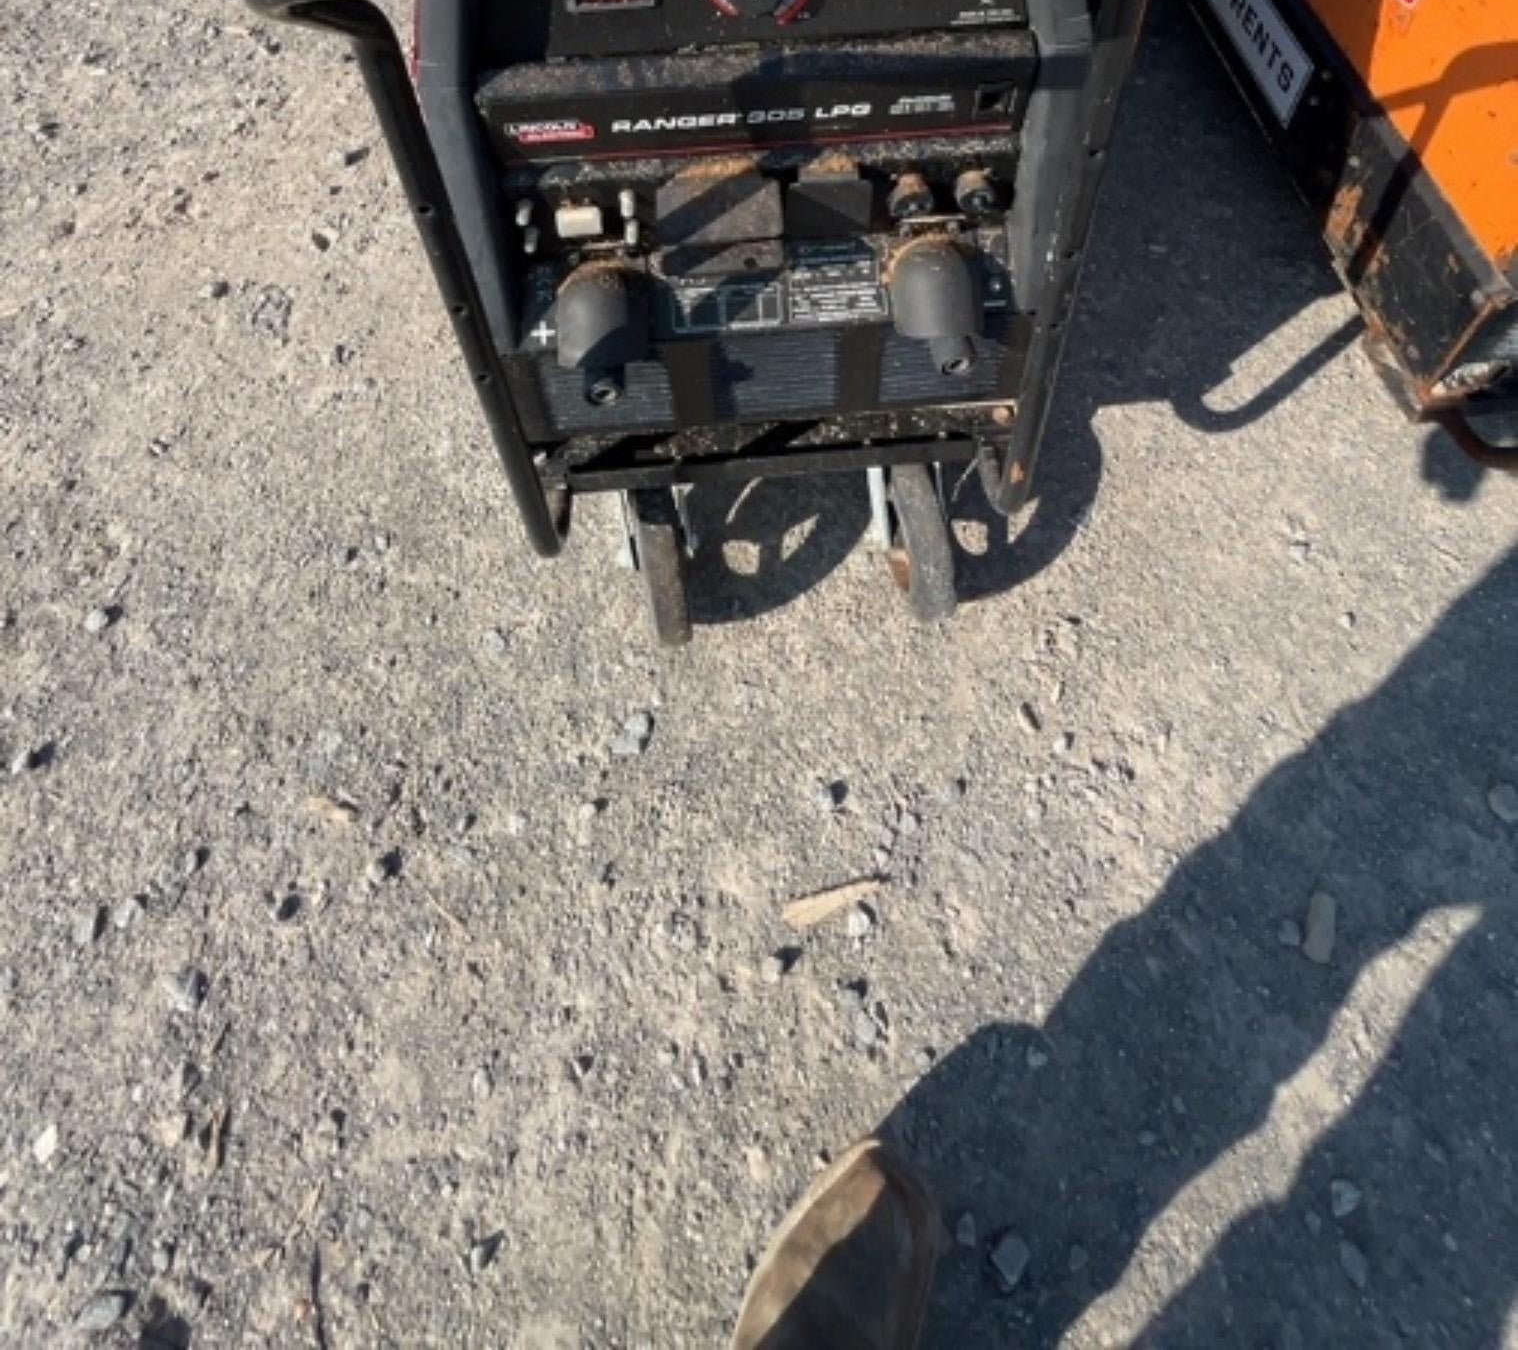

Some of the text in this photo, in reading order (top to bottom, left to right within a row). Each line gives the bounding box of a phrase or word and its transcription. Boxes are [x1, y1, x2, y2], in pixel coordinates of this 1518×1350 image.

[611, 113, 737, 133] RANGER
[746, 107, 805, 124] 305
[815, 102, 872, 119] LPG
